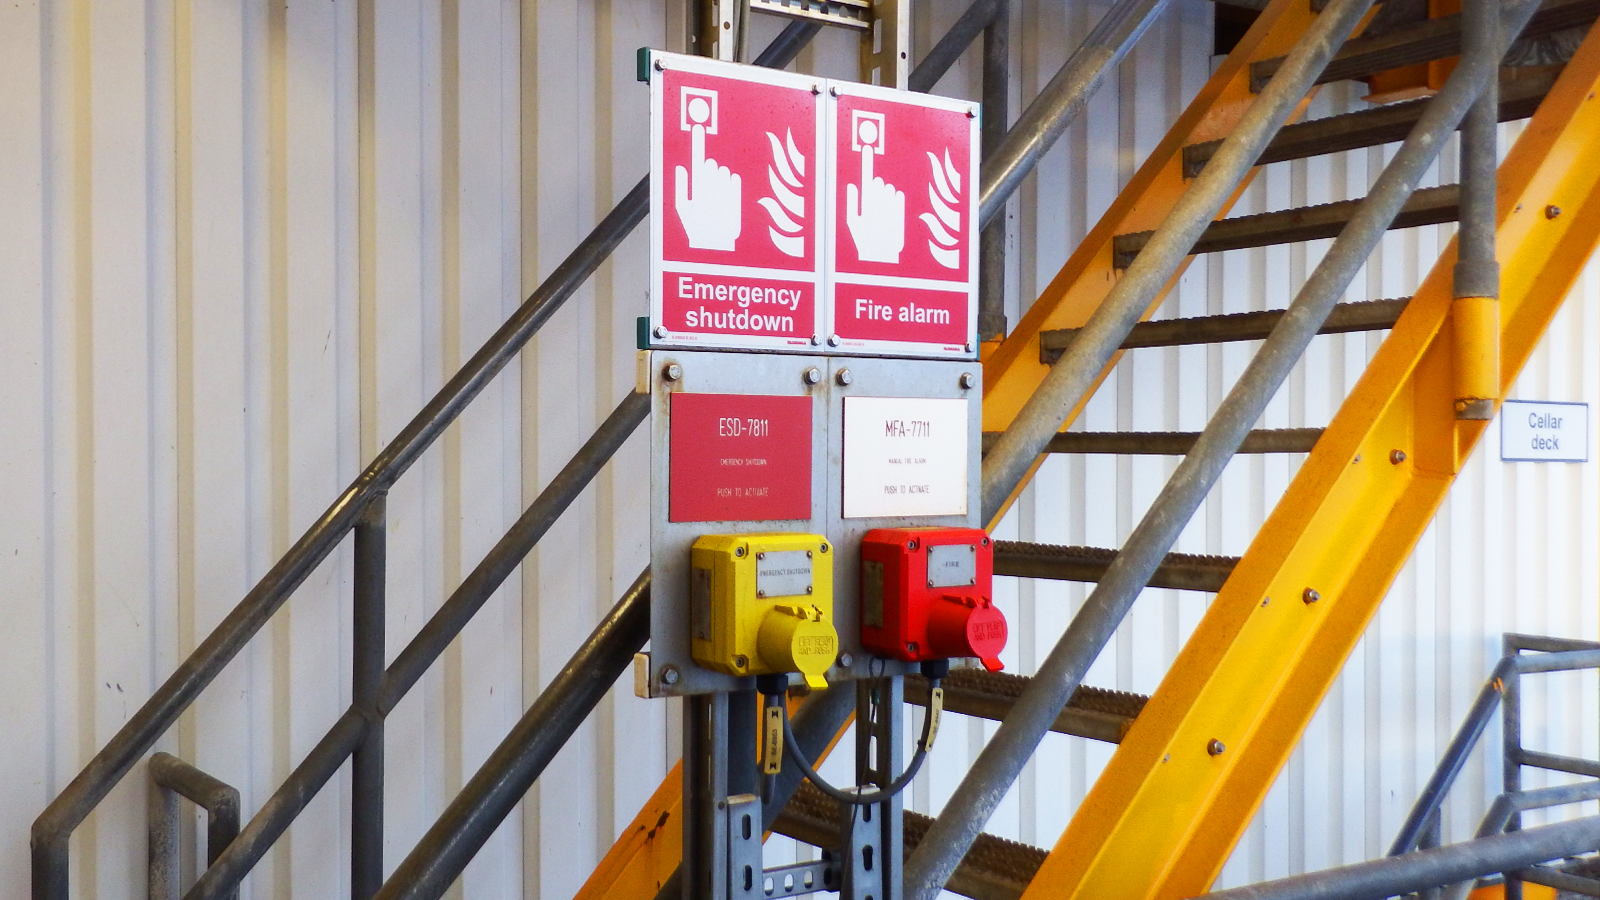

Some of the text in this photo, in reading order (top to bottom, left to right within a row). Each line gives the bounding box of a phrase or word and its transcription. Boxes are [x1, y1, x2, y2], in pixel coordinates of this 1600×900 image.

[678, 276, 801, 311] Emergency
[685, 305, 794, 332] shutdown
[855, 298, 950, 325] Fire alarm
[719, 417, 769, 437] ESD-7811
[885, 419, 930, 438] MFA-7711
[1528, 412, 1562, 429] Cellar
[1531, 433, 1559, 450] deck
[717, 487, 769, 498] PUSH TO ACTIVATE
[884, 485, 930, 495] PUSH TO ACTIVATE
